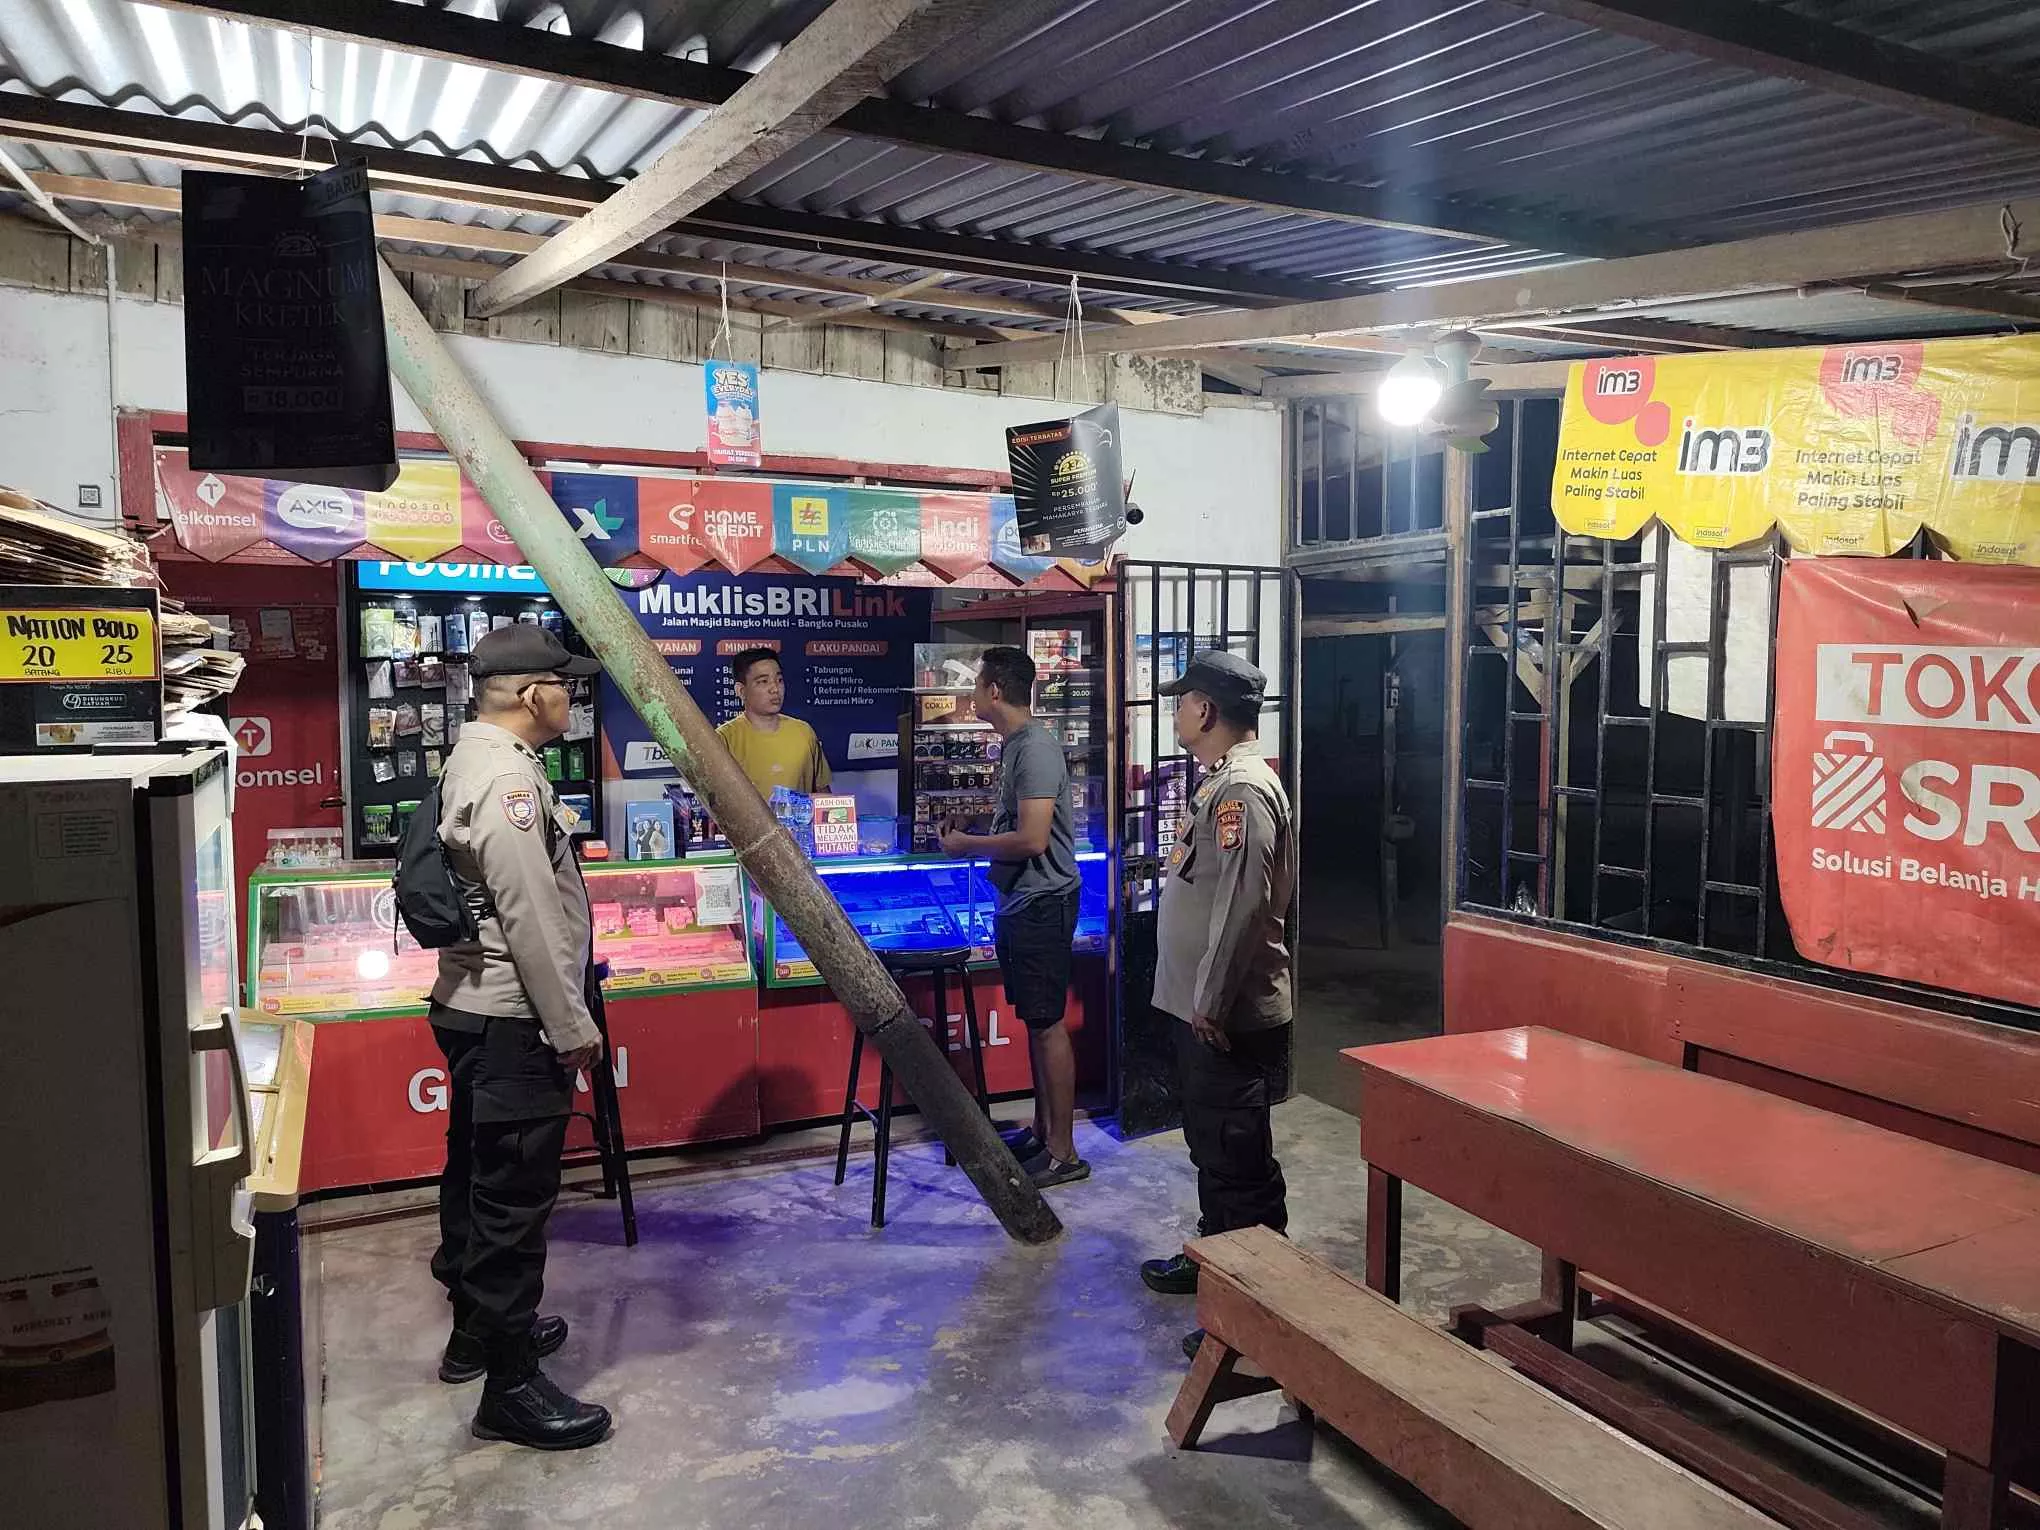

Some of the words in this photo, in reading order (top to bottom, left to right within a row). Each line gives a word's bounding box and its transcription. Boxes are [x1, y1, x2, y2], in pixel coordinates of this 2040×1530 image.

[200, 262, 369, 300] MAGNUM
[1841, 351, 1902, 383] im3
[713, 370, 749, 388] YES
[1598, 367, 1641, 394] im3
[1679, 418, 1772, 473] im3
[1562, 449, 1615, 462] Internet
[1619, 449, 1657, 465] Cepat
[1796, 449, 1863, 464] Internet
[1868, 449, 1921, 467] Cepat
[1570, 467, 1608, 480] Makin
[1612, 467, 1642, 481] Luas
[1806, 470, 1856, 486] Makin
[1860, 471, 1903, 488] Luas
[1565, 484, 1602, 501] Paling
[1605, 485, 1645, 500] Stabil
[288, 499, 345, 515] AXIS
[1797, 492, 1848, 511] Paling
[1852, 494, 1905, 511] Stabil
[177, 510, 256, 527] elkomsel
[704, 510, 757, 524] HOME
[705, 523, 764, 538] CREDIT
[639, 585, 907, 617] MuklisBRILink
[6, 615, 86, 641] NATION
[92, 617, 139, 641] BOLD
[662, 617, 688, 627] Jalan
[690, 617, 722, 629] Masjid
[724, 618, 761, 629] Bangko
[762, 619, 790, 629] Mukti
[798, 619, 833, 630] Bangko
[835, 620, 869, 629] Pusako
[657, 642, 697, 652] YANAN
[813, 643, 840, 653] LAKU
[842, 643, 880, 653] PANDAI
[21, 645, 56, 668] 20
[100, 644, 134, 666] 25
[814, 666, 853, 676] Tabungan
[813, 676, 839, 685] Kredit
[841, 676, 864, 685] Mikro
[1852, 651, 2040, 725] TOK
[814, 697, 849, 705] Asuransi
[851, 697, 874, 705] Mikro
[235, 761, 323, 788] omsel
[817, 824, 855, 834] TIDAK
[817, 843, 857, 853] HUTANG
[1811, 848, 1892, 879] Solusi
[1899, 857, 2008, 899] Belanja
